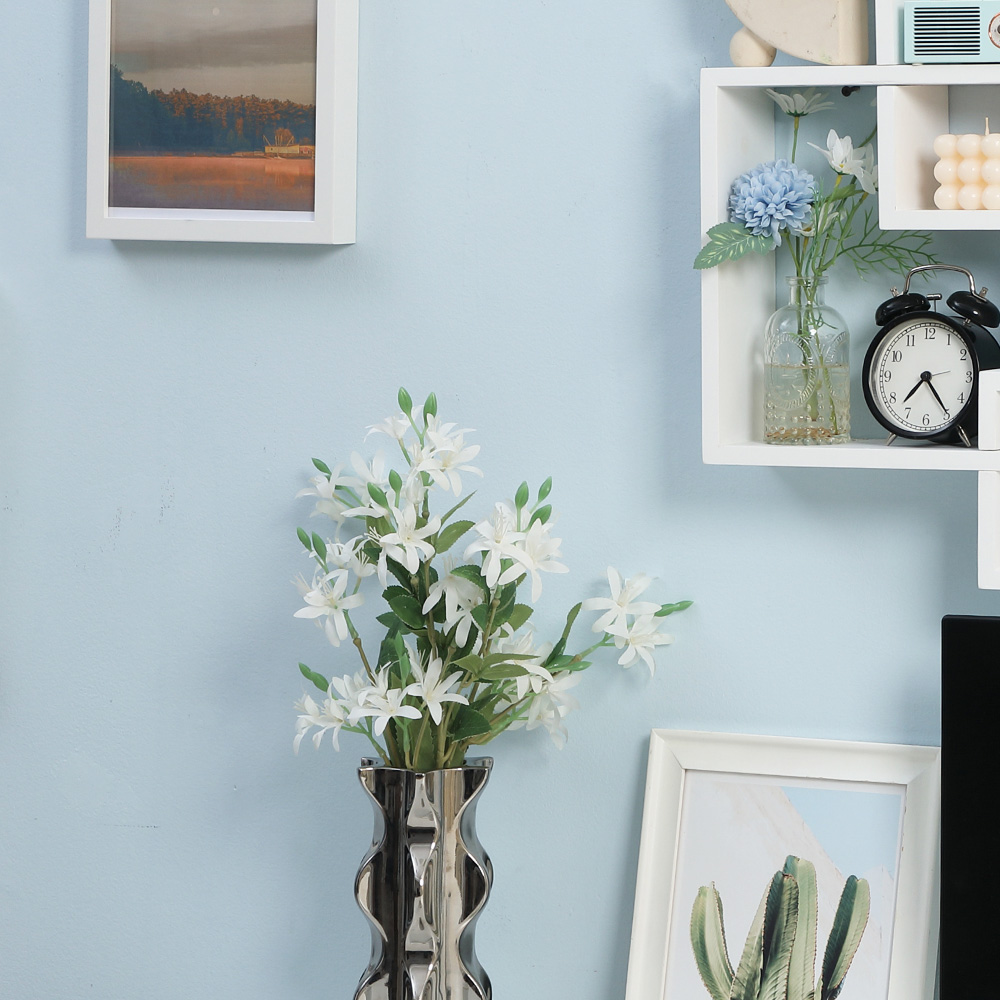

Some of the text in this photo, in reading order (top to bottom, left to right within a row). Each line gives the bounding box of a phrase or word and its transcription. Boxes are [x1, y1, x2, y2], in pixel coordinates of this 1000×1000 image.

[924, 328, 936, 340] 12
[946, 334, 951, 346] 1
[905, 335, 915, 347] 11
[891, 350, 903, 362] 10
[960, 349, 967, 361] 2
[883, 370, 892, 383] 9
[965, 371, 973, 384] 3
[889, 392, 897, 404] 8
[957, 392, 965, 404] 4
[904, 407, 912, 419] 7
[943, 408, 951, 421] 5
[922, 414, 930, 426] 6
